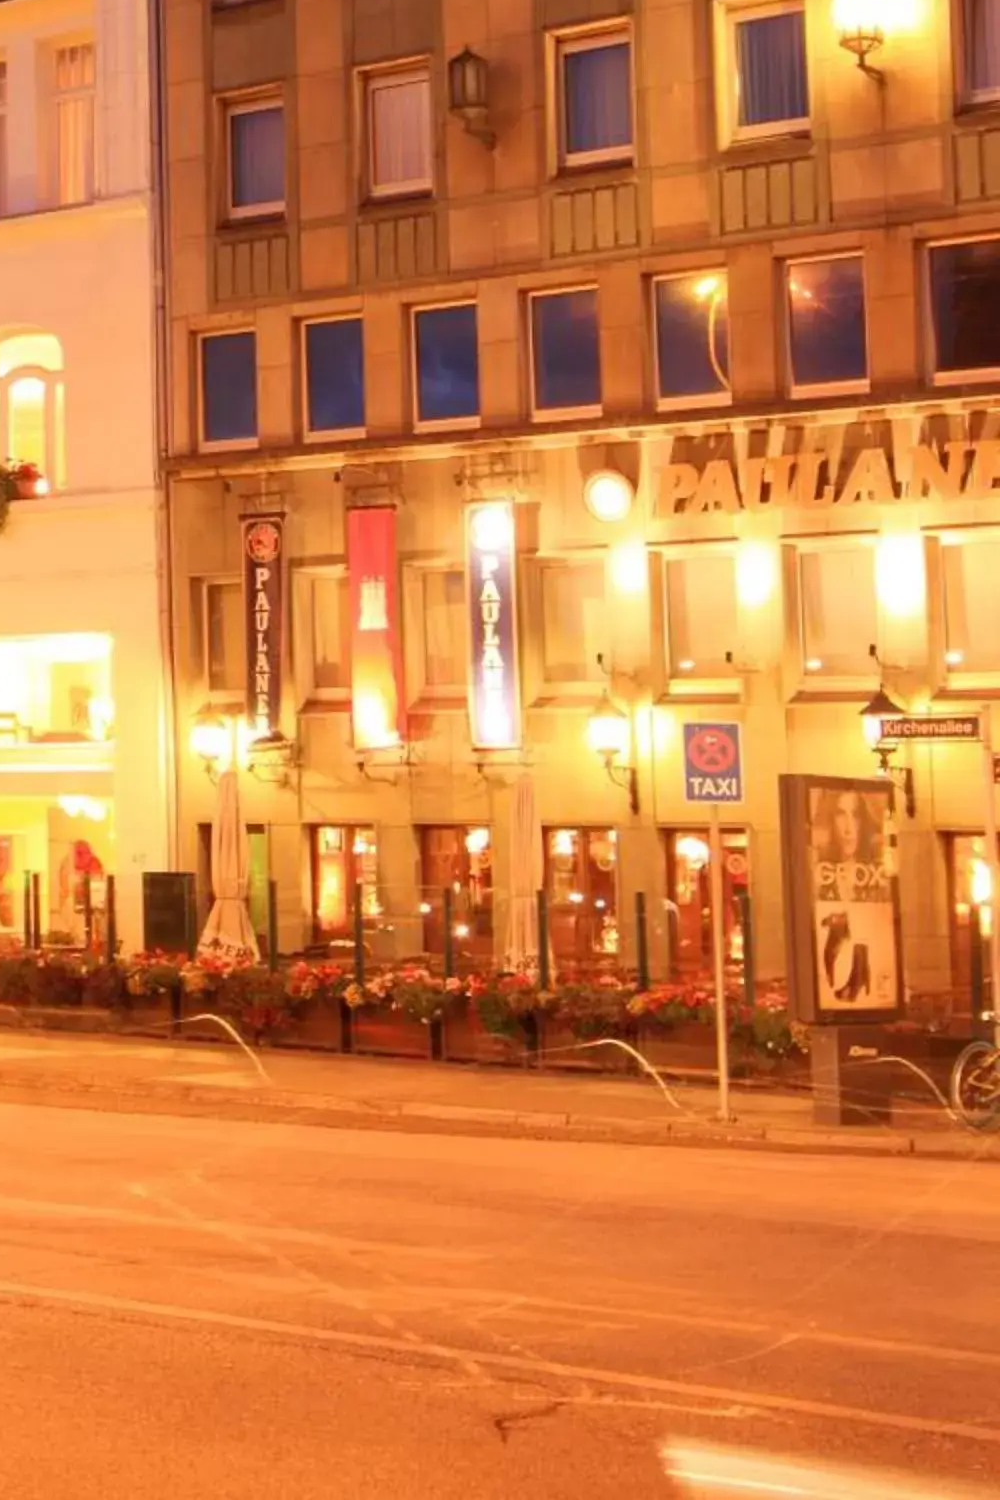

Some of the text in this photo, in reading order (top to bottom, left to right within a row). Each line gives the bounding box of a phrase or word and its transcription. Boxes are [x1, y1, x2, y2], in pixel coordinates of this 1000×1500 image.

[480, 554, 506, 740] PAULA
[883, 720, 974, 736] Kirchenallee
[688, 777, 738, 797] TAXI
